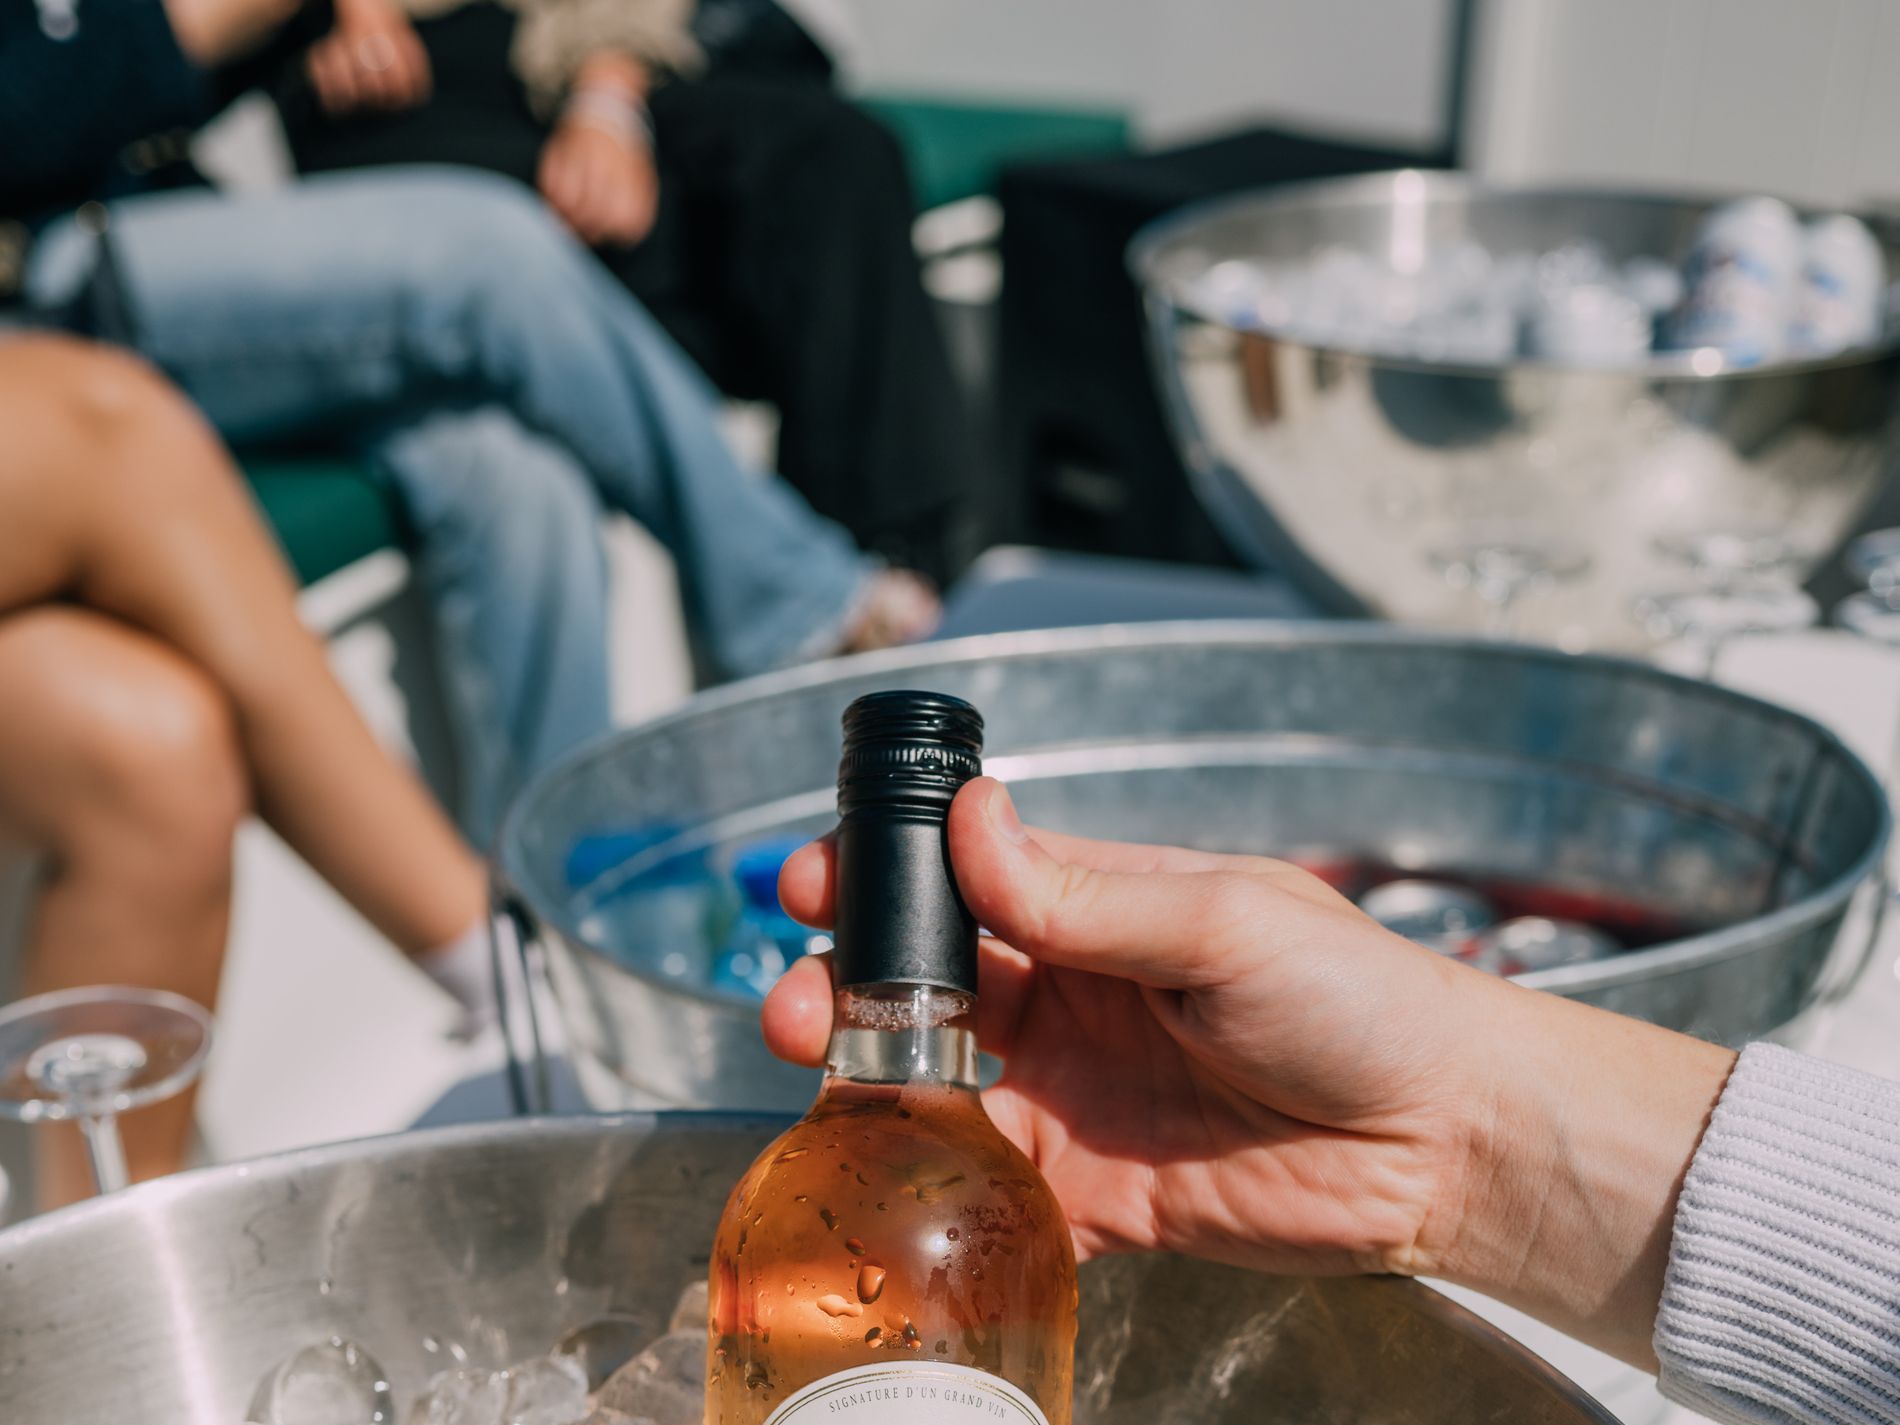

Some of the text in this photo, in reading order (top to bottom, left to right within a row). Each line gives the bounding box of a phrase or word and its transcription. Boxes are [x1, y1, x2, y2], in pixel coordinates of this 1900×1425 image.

[829, 1386, 1007, 1419] SIGNATURE D'UN GRAND VIN
